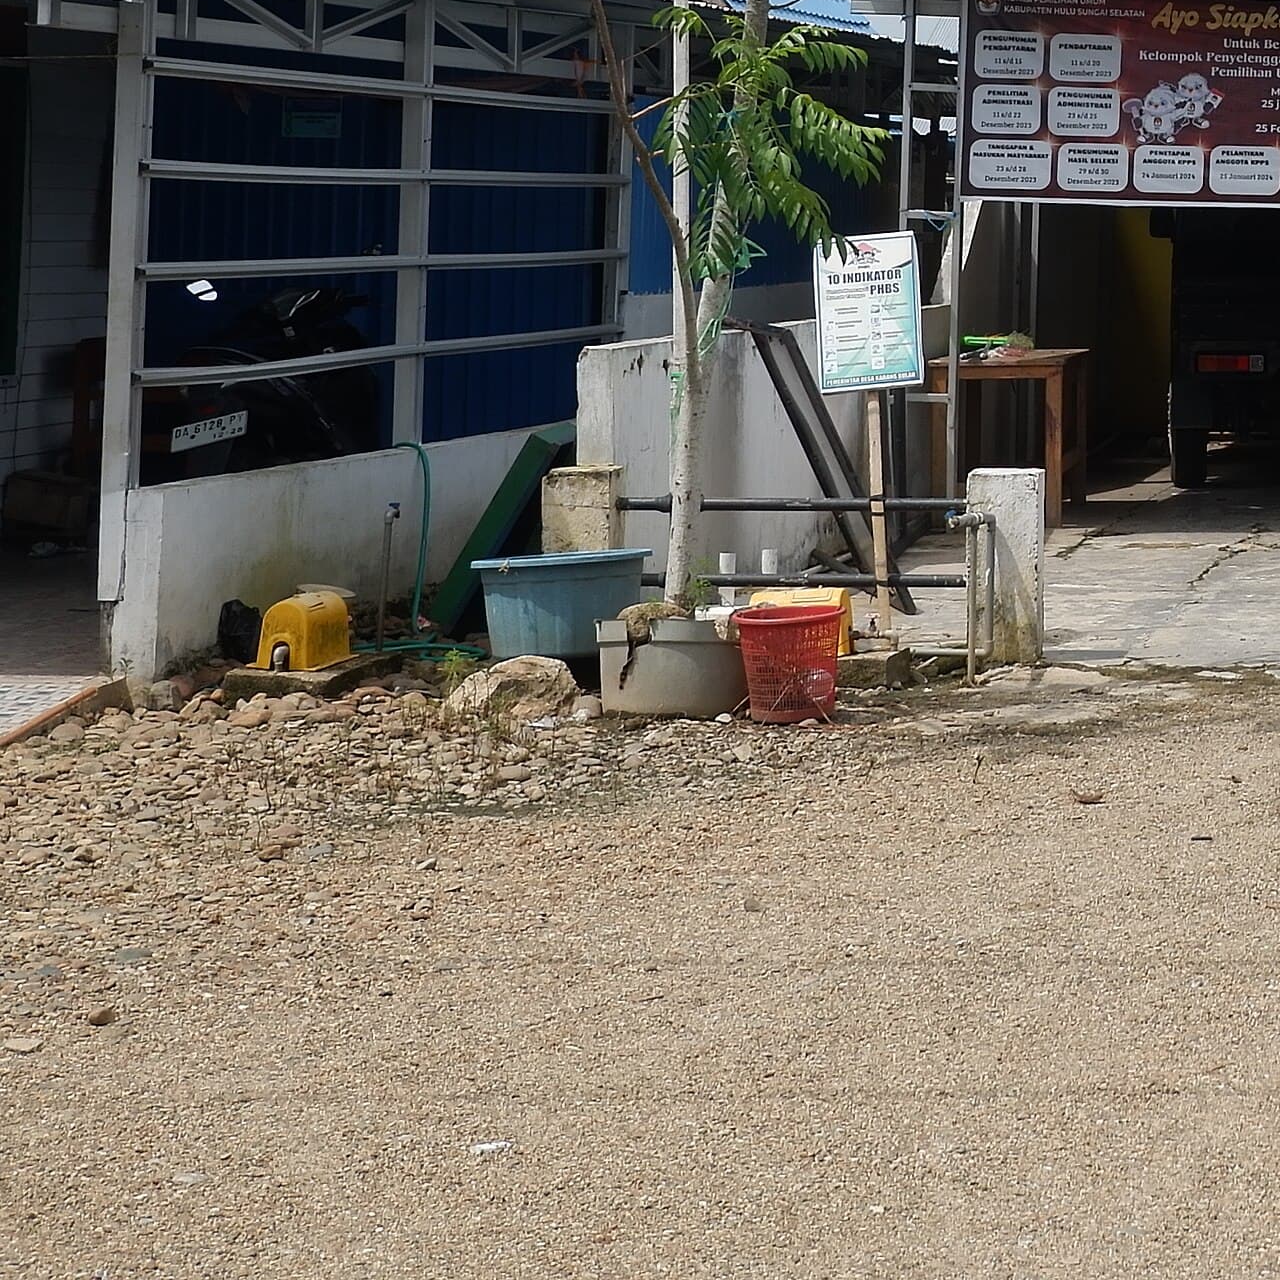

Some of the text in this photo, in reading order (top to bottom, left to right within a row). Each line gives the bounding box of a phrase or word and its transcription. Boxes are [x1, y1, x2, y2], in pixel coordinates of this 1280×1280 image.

[1004, 5, 1145, 17] KABUPATEN HULU SUNGAI SELATAN
[1151, 1, 1200, 35] Ayo
[1223, 38, 1260, 49] Untuk
[1139, 50, 1202, 64] Kelompok
[1211, 66, 1272, 78] Pemilihan
[1261, 100, 1274, 109] 25
[1256, 124, 1268, 133] 25
[827, 269, 902, 285] 10 INDIKATOR
[870, 282, 900, 295] PHBS
[175, 427, 189, 439] DA
